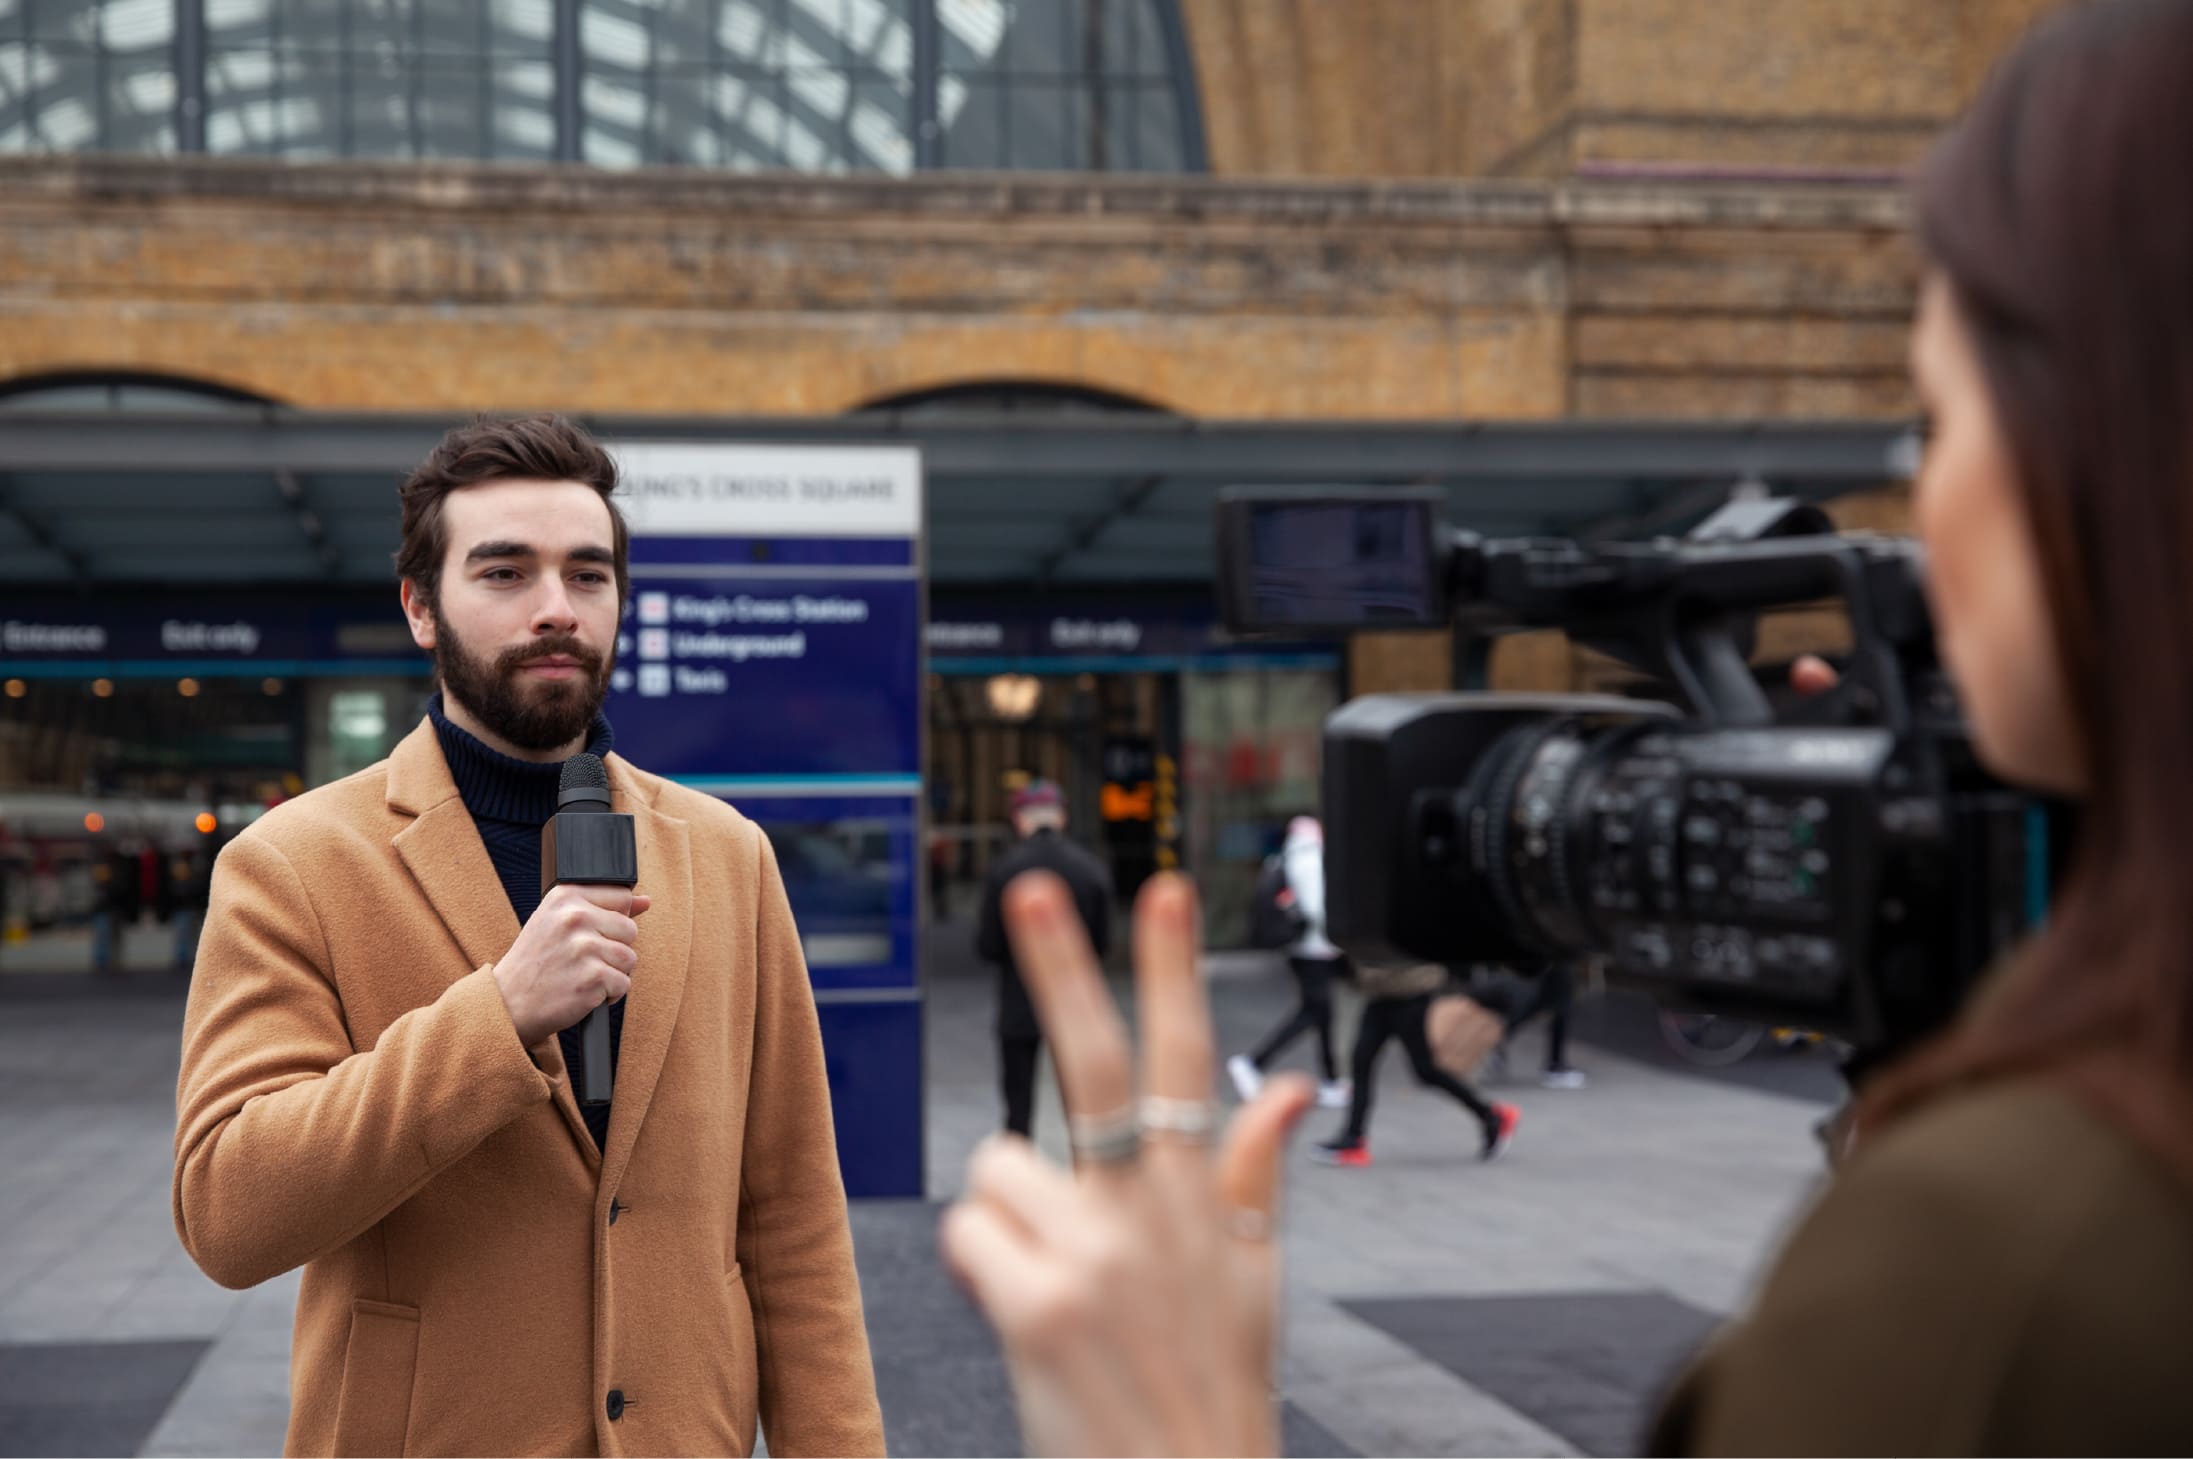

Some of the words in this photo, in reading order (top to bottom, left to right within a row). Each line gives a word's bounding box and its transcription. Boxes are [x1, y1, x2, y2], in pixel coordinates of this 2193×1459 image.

[711, 473, 790, 499] CROSS
[799, 473, 896, 501] SQUARE
[734, 596, 790, 621] Cross
[793, 596, 867, 621] Station
[673, 630, 805, 661] Underground
[923, 623, 1002, 646] ntrance
[675, 666, 727, 693] Taxis
